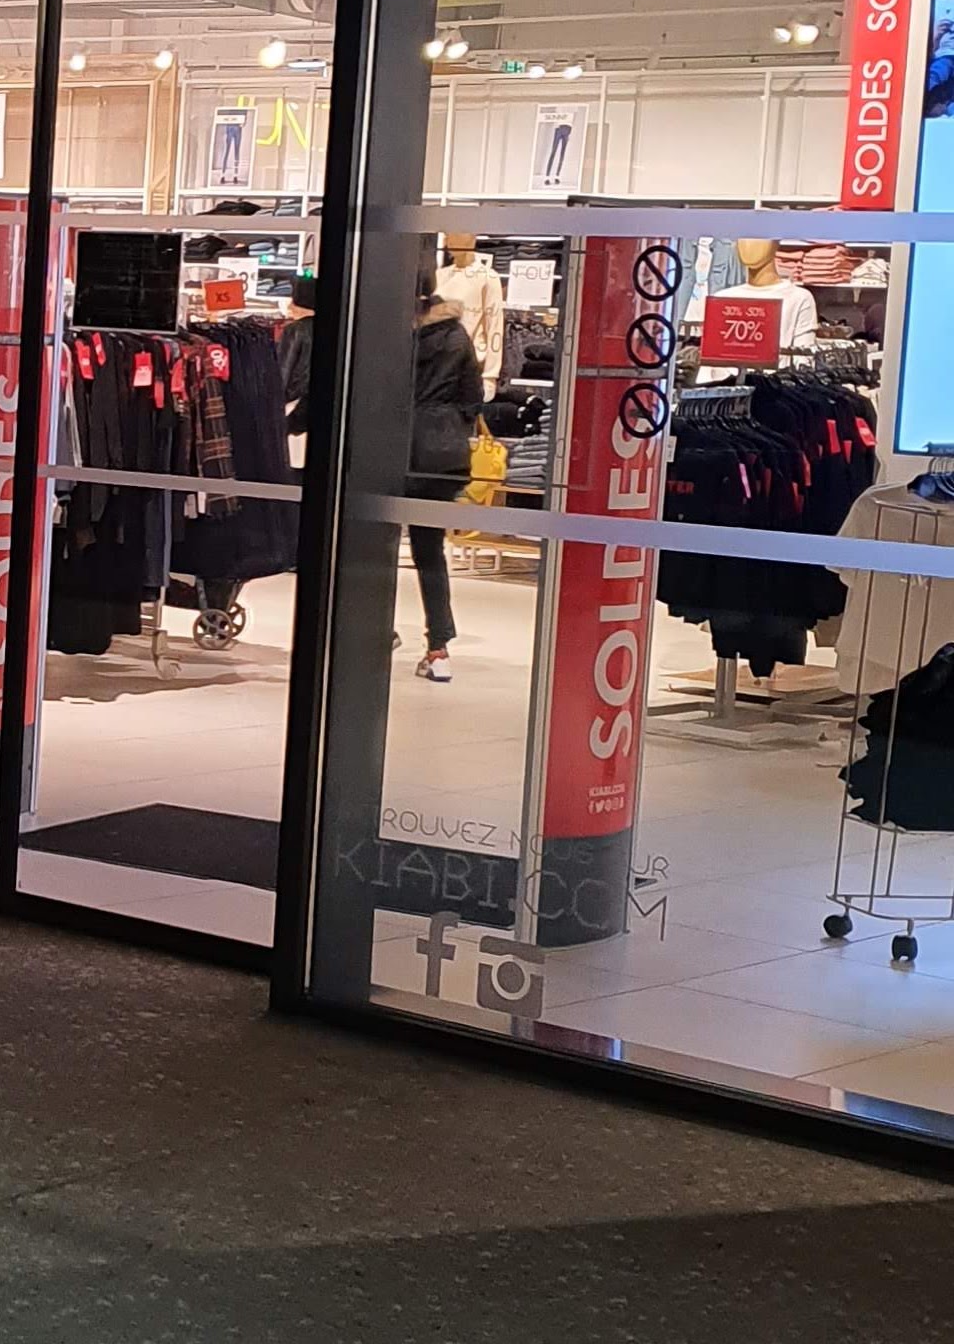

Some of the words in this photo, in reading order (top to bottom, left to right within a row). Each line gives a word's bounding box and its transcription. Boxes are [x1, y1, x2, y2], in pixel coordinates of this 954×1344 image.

[852, 58, 894, 197] SOLDES
[719, 319, 764, 342] -70%
[589, 412, 656, 760] SOLDES
